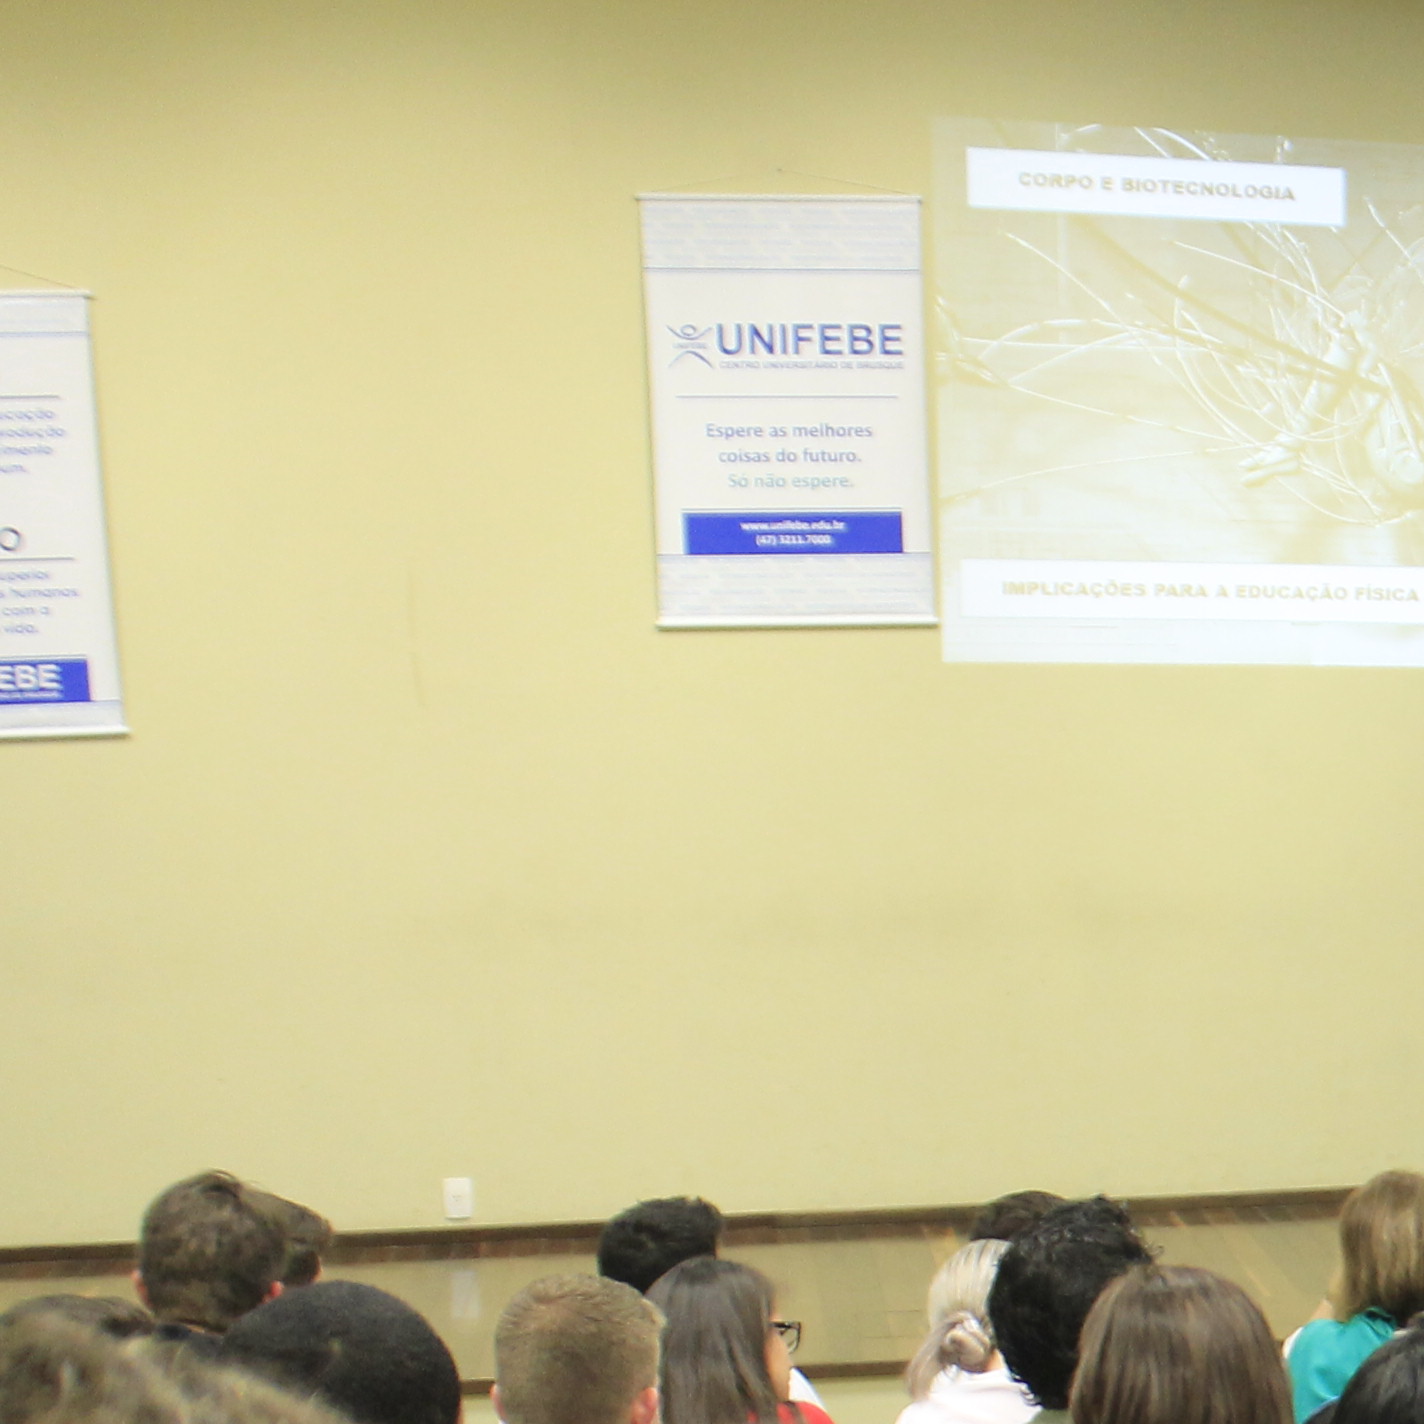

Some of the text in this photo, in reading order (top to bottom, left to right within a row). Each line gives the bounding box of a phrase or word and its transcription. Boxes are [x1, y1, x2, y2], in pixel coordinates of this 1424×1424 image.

[1018, 170, 1296, 201] CORPO E BIOTECNOLOGIA
[714, 322, 905, 356] UNIFEBE
[705, 423, 873, 439] Espere as melhores
[718, 447, 861, 463] coisas do futuro.
[727, 472, 854, 491] Só não espere.
[1001, 578, 1421, 604] IMPLICAÇÕES PARA A EDUCAÇÃO FÍSICA
